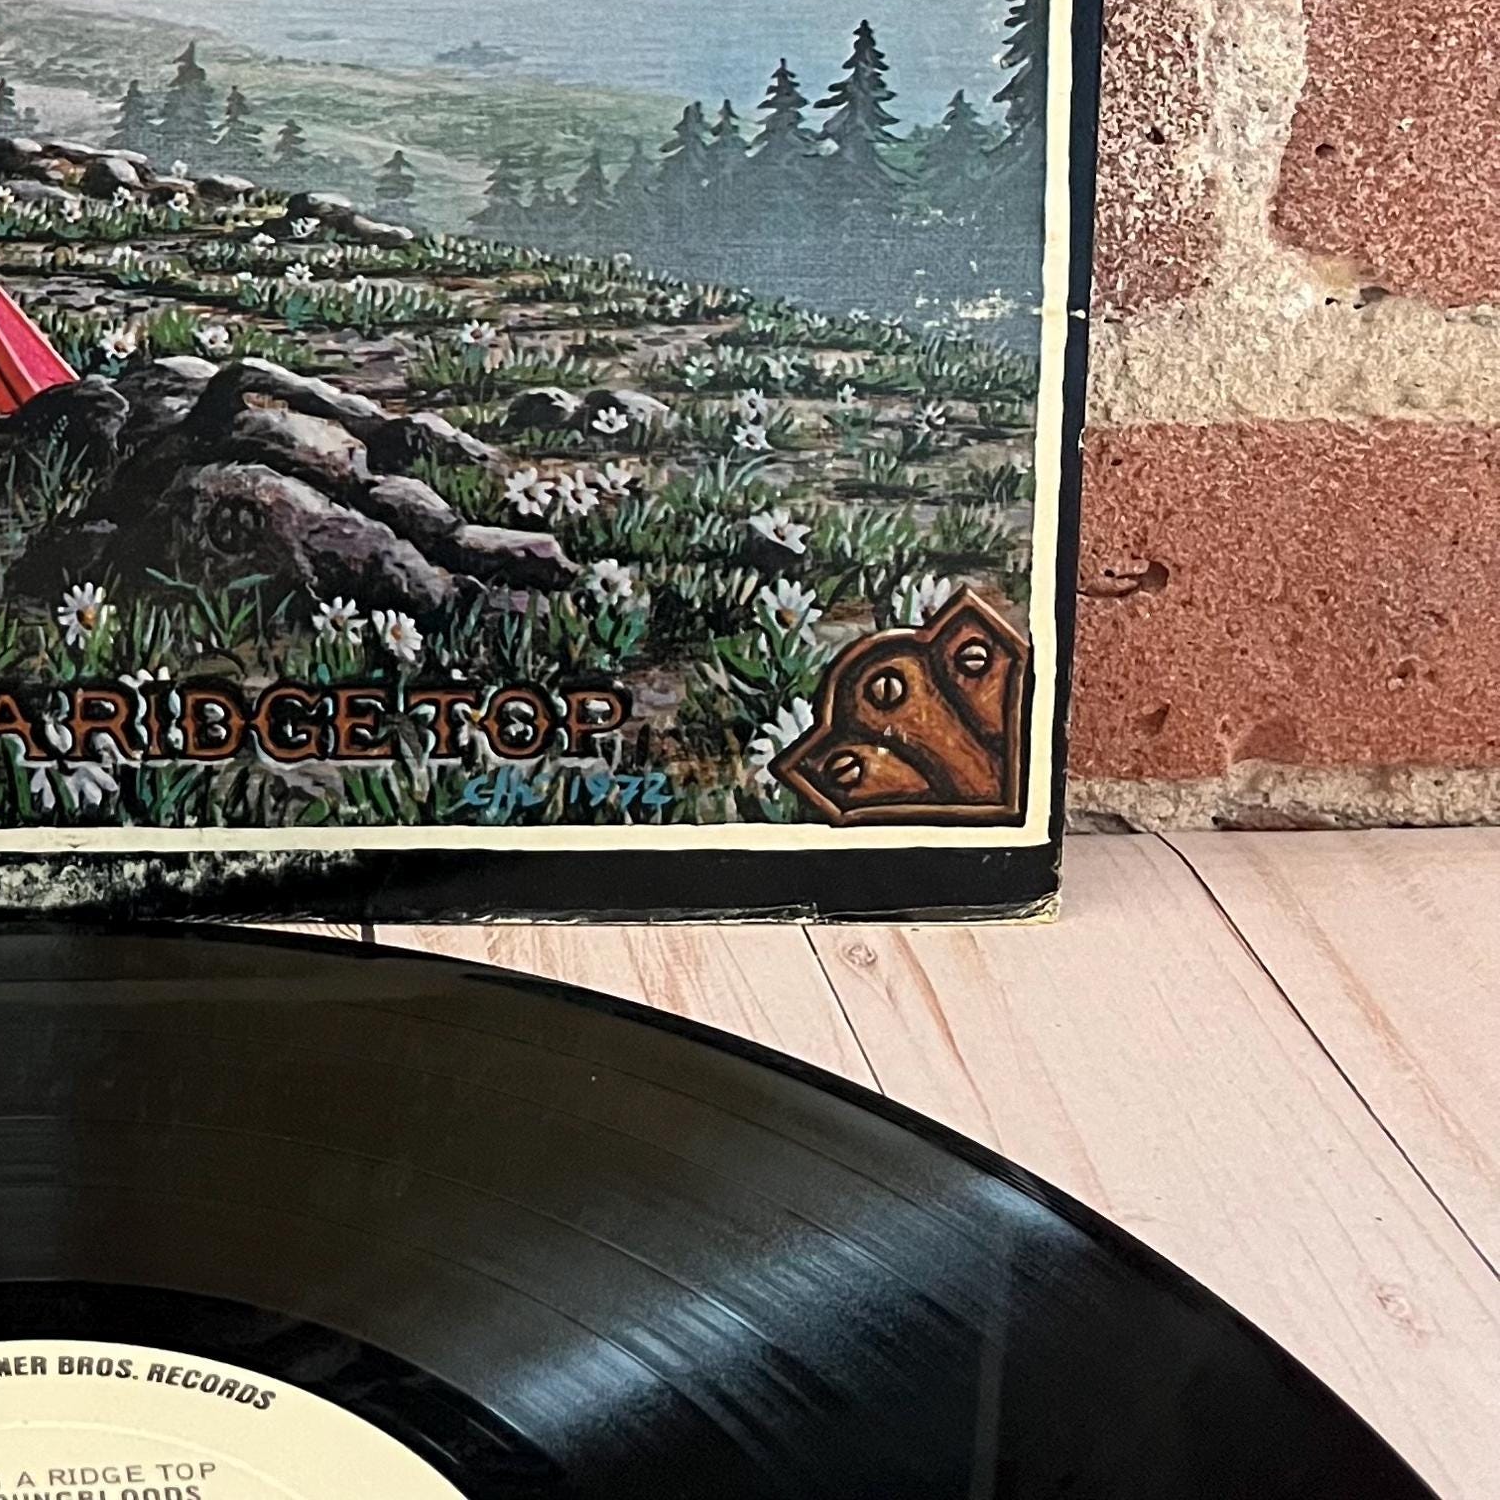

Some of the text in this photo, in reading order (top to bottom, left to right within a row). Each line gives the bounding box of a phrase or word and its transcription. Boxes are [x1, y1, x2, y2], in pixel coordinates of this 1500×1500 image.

[67, 688, 393, 760] RIDGE
[408, 690, 626, 759] TOP
[569, 772, 673, 808] 1972
[58, 1356, 138, 1380] BROS.
[147, 1363, 276, 1410] RECORDS
[16, 1471, 36, 1488] A
[48, 1465, 145, 1486] RIDGE
[155, 1462, 216, 1482] TOP
